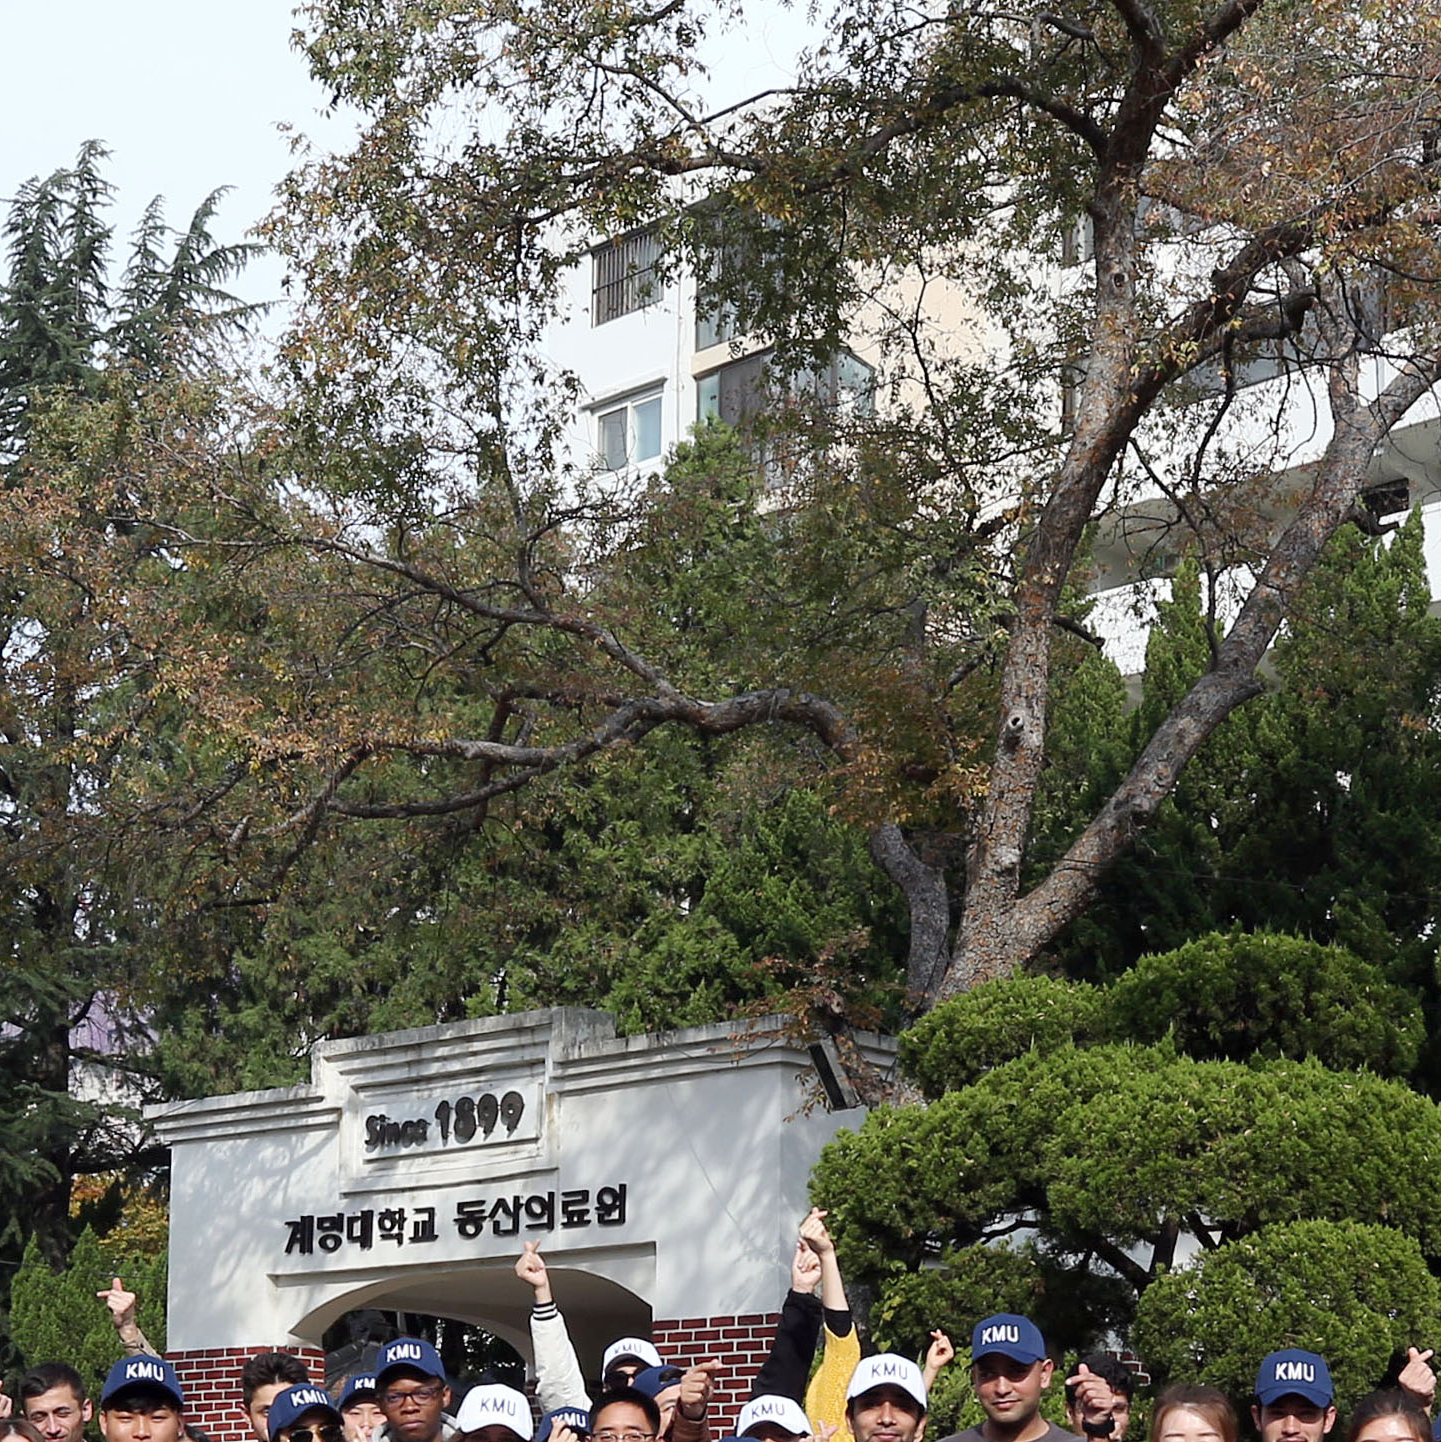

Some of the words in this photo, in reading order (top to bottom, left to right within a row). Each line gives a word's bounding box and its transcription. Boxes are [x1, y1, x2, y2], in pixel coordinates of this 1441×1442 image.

[364, 1113, 430, 1150] Since
[434, 1090, 526, 1147] 1899
[284, 1206, 440, 1255] 계명대학교
[453, 1183, 628, 1240] 동산의료원
[981, 1325, 1019, 1345] KMU
[386, 1344, 421, 1362] KMU
[614, 1343, 642, 1353] KMU
[126, 1362, 163, 1381] KMU
[871, 1363, 907, 1380] KMU
[1275, 1361, 1314, 1382] KMU
[355, 1378, 375, 1390] KM
[290, 1390, 327, 1406] KMU
[480, 1398, 515, 1416] KMU
[751, 1405, 785, 1419] KMU
